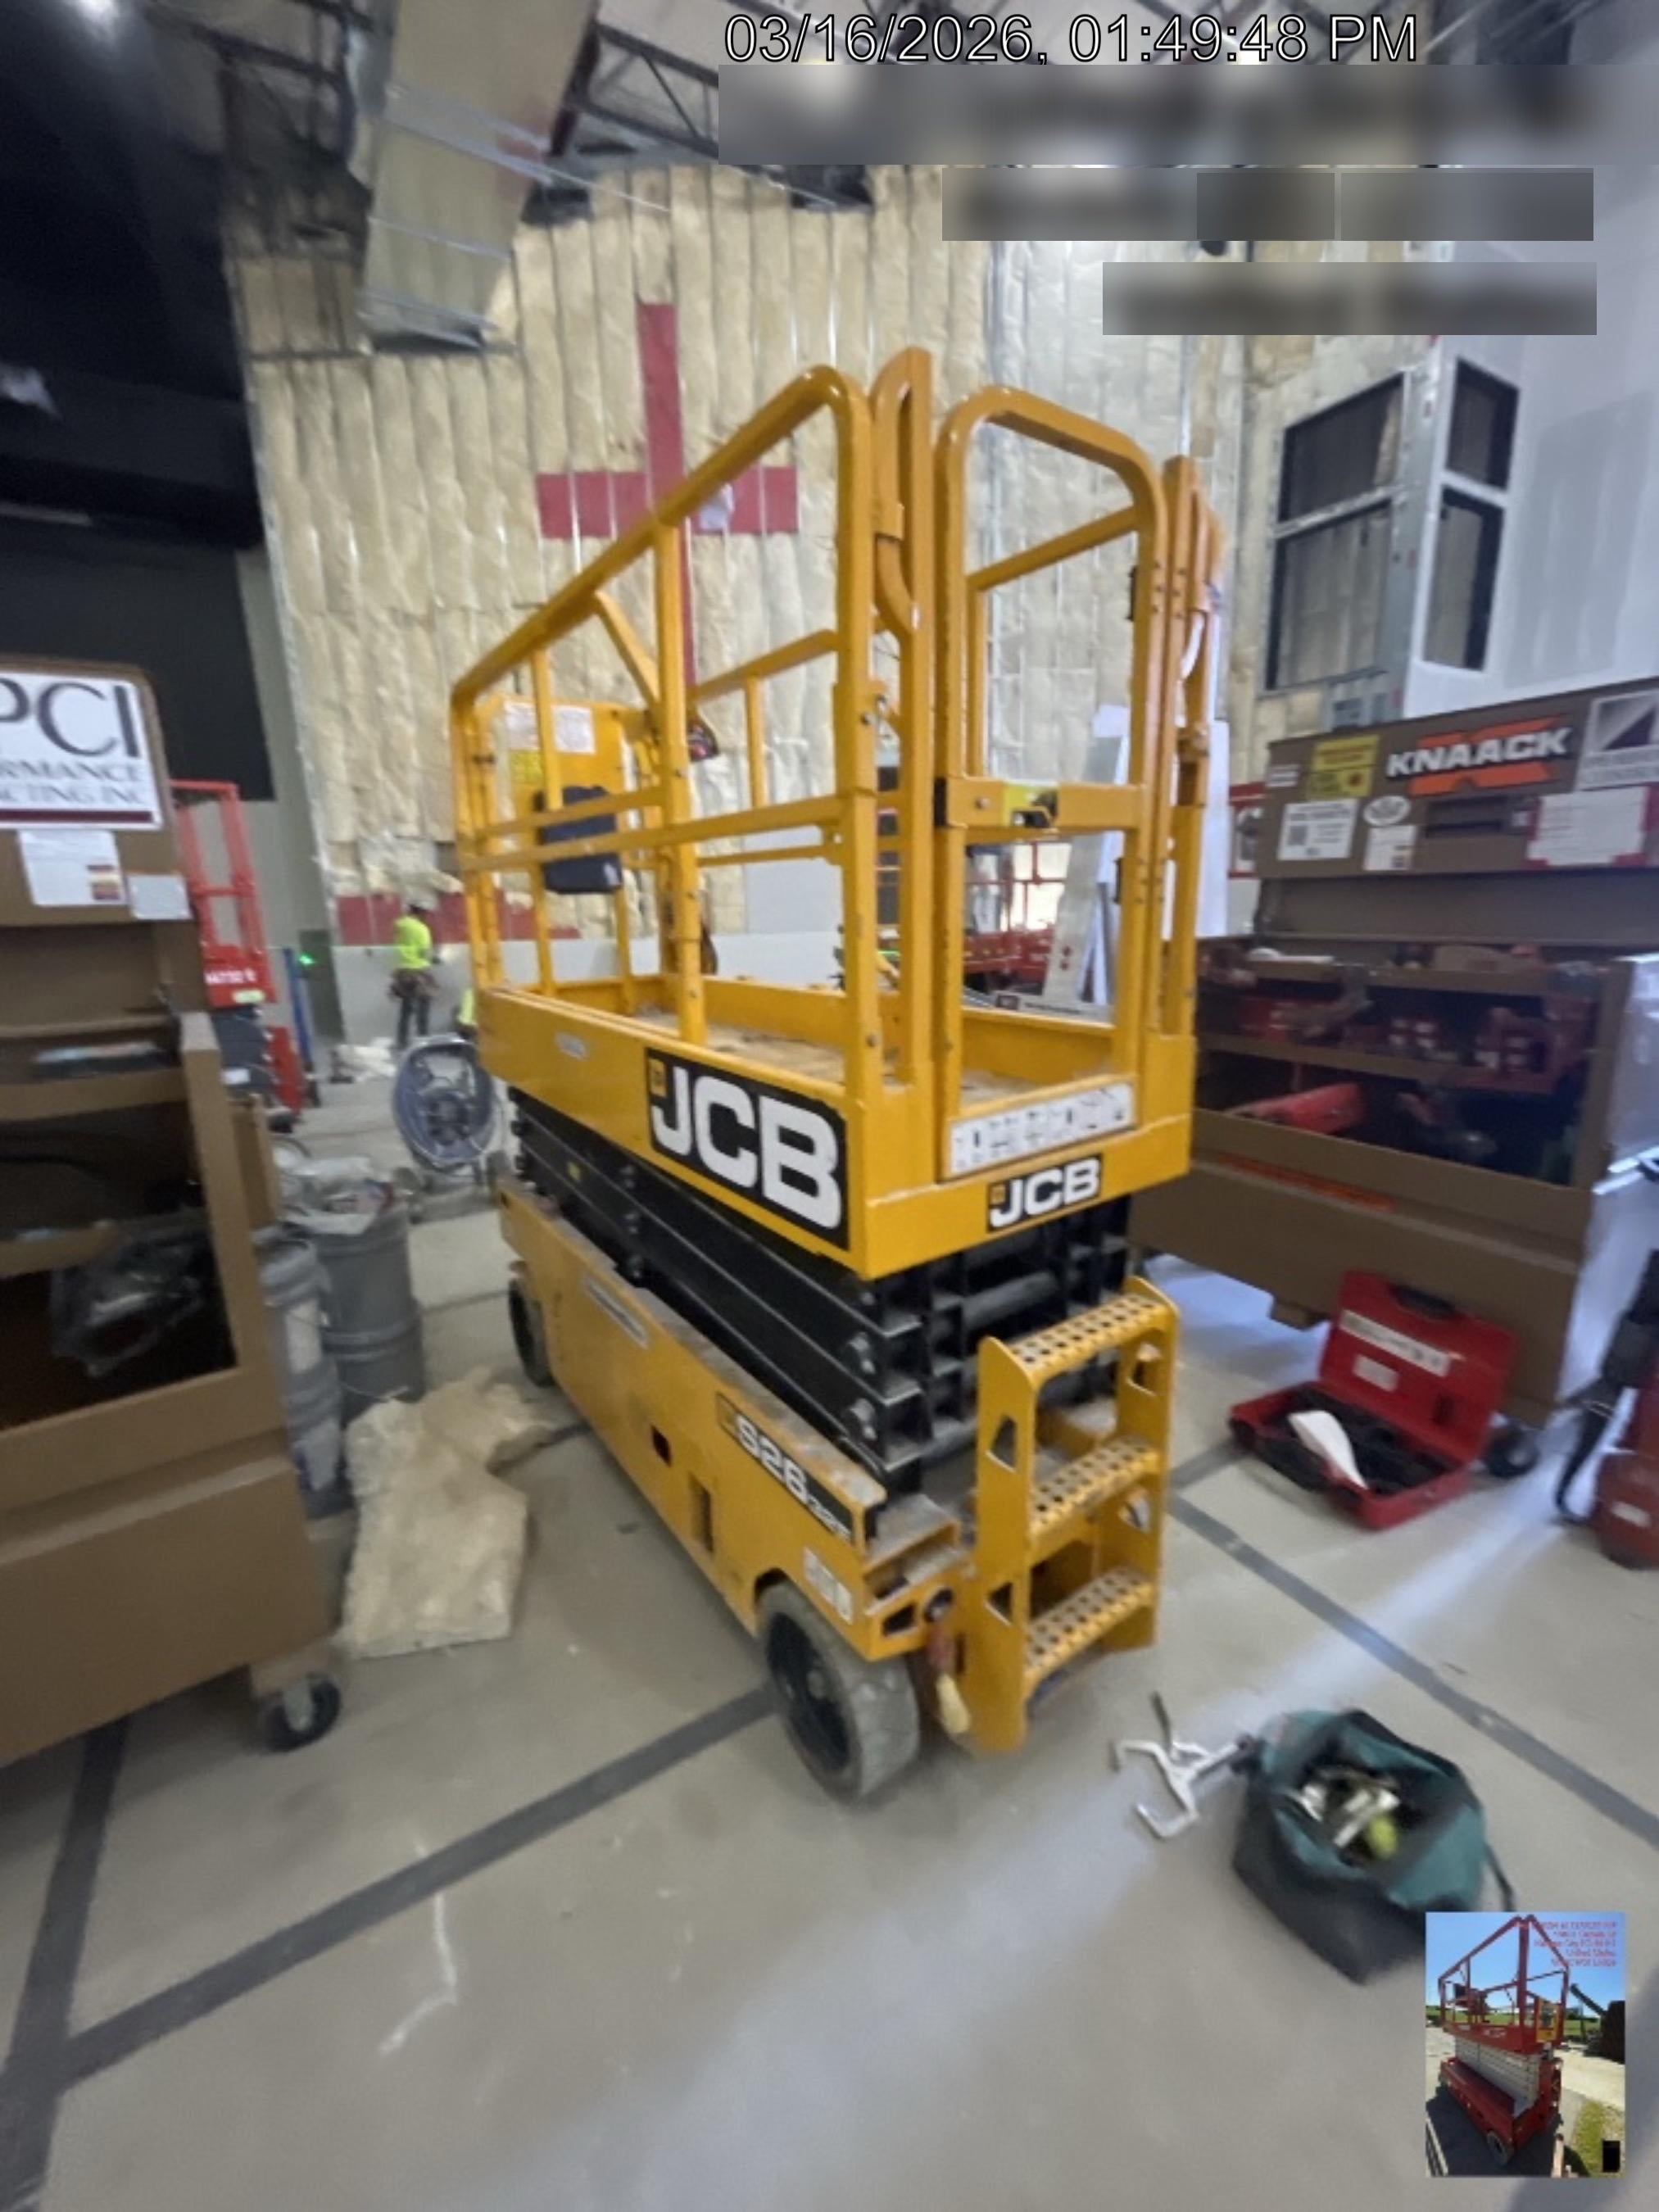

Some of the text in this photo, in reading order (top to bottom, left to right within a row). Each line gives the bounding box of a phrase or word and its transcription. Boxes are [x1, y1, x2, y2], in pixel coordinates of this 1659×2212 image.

[1386, 726, 1572, 777] KNAACK
[652, 1066, 843, 1231] JCB
[989, 1157, 1100, 1228] JCB
